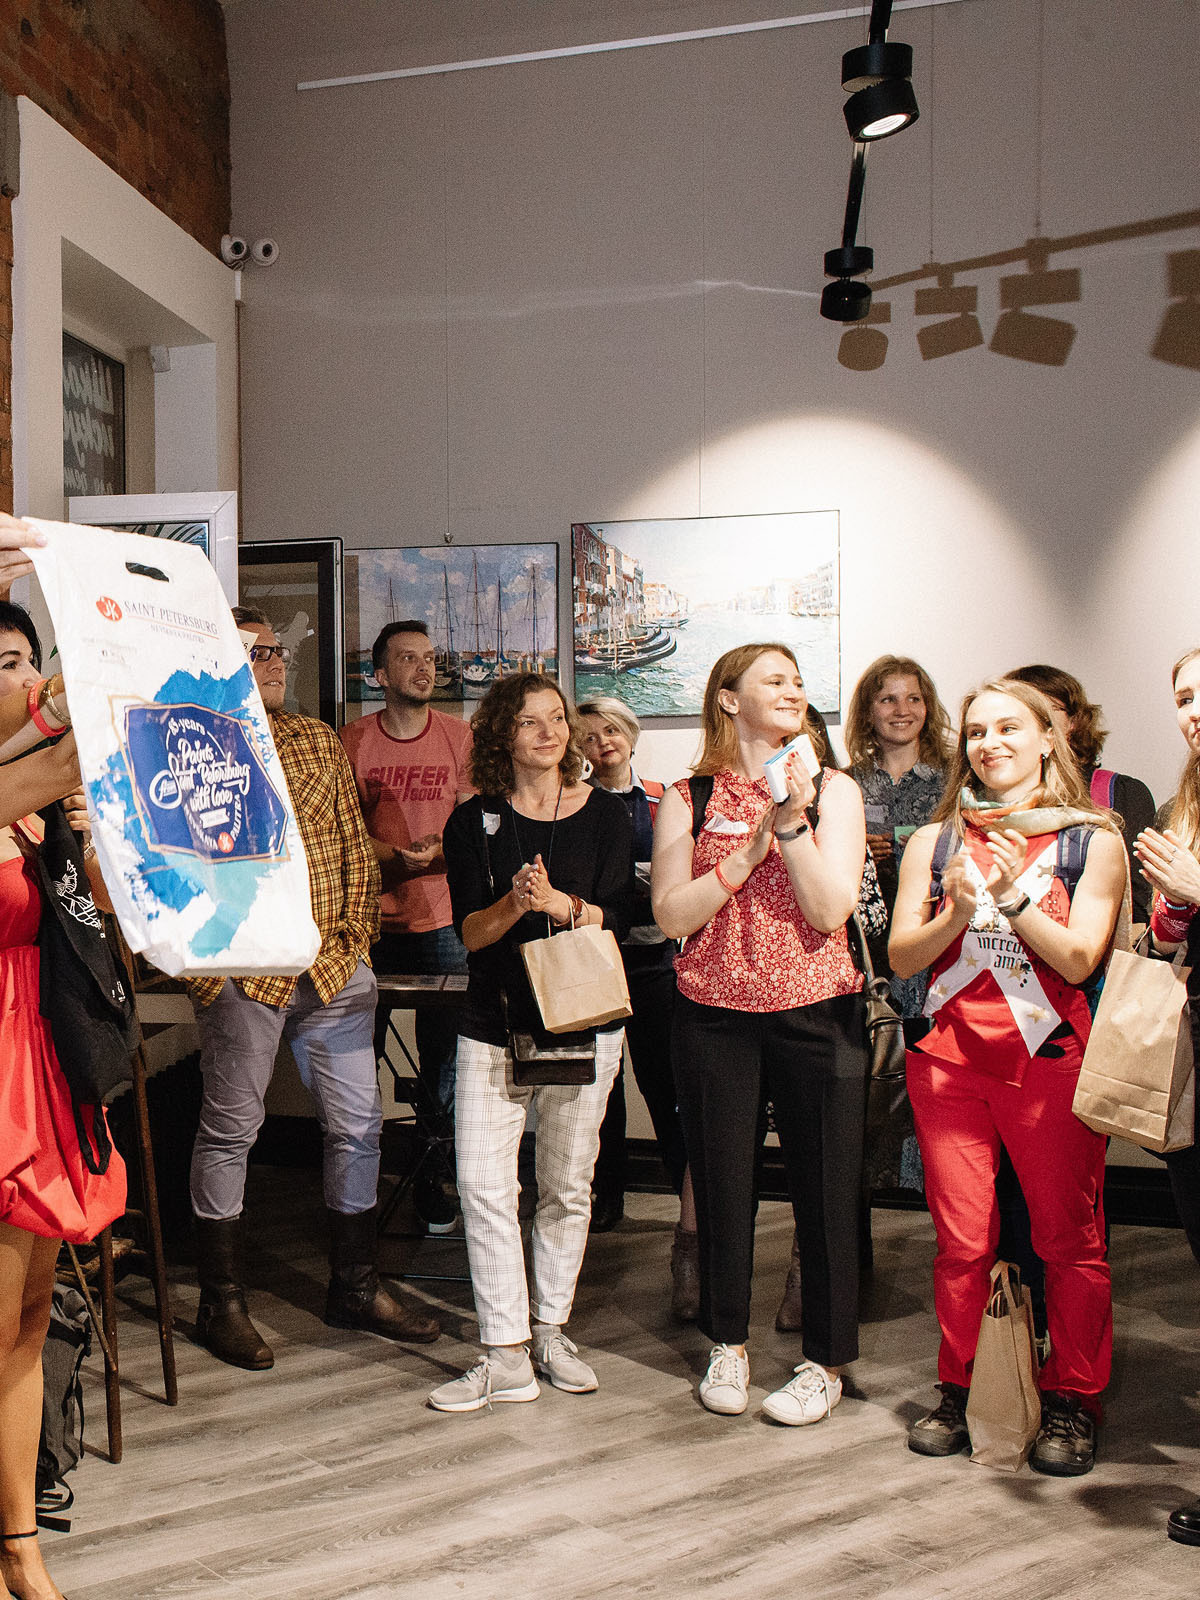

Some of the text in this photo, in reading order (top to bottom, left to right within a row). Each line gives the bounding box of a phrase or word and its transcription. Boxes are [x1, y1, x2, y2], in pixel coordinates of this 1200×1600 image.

[124, 600, 218, 635] SAINT PETERSBURG
[178, 738, 215, 767] Paints
[197, 752, 251, 796] Petersburg
[367, 765, 449, 801] SURFER
[189, 785, 211, 812] with
[410, 787, 444, 801] SOUL
